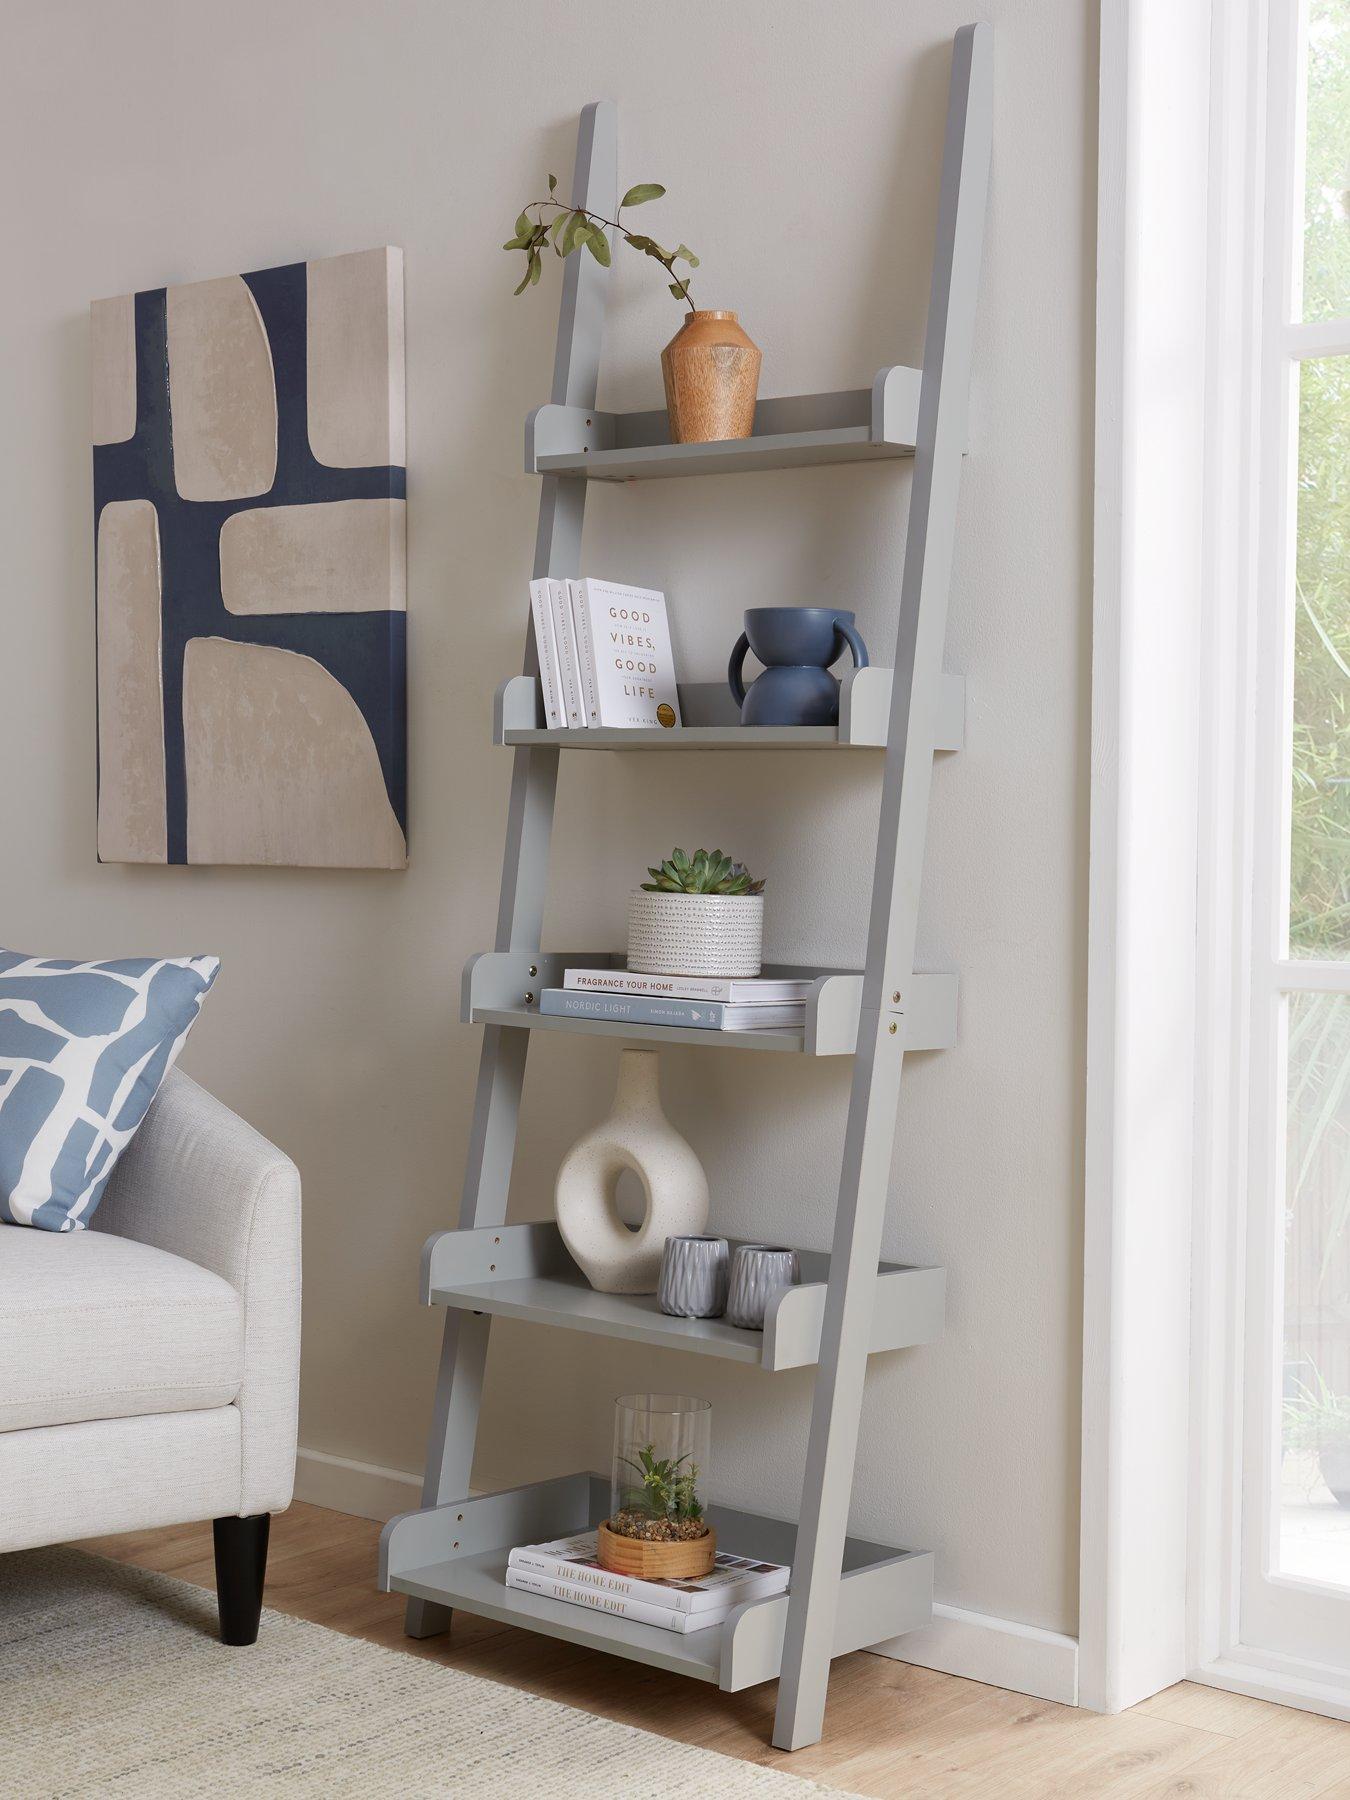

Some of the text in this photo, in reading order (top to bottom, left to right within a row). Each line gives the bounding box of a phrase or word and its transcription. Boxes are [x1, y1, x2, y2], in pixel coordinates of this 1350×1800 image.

[609, 607, 650, 623] GOOD
[610, 632, 656, 651] VIBES,
[615, 658, 657, 673] GOOD
[624, 684, 655, 699] LIFE
[577, 977, 624, 988] FRAGRANCE
[626, 980, 648, 990] YOUR
[650, 981, 674, 992] HOME
[565, 1000, 601, 1011] NORDIC
[604, 1003, 632, 1014] LIGHT
[556, 1565, 576, 1579] THE
[578, 1571, 607, 1588] HOME
[608, 1579, 633, 1594] EDIT
[552, 1584, 628, 1614] THE HOME EDIT
